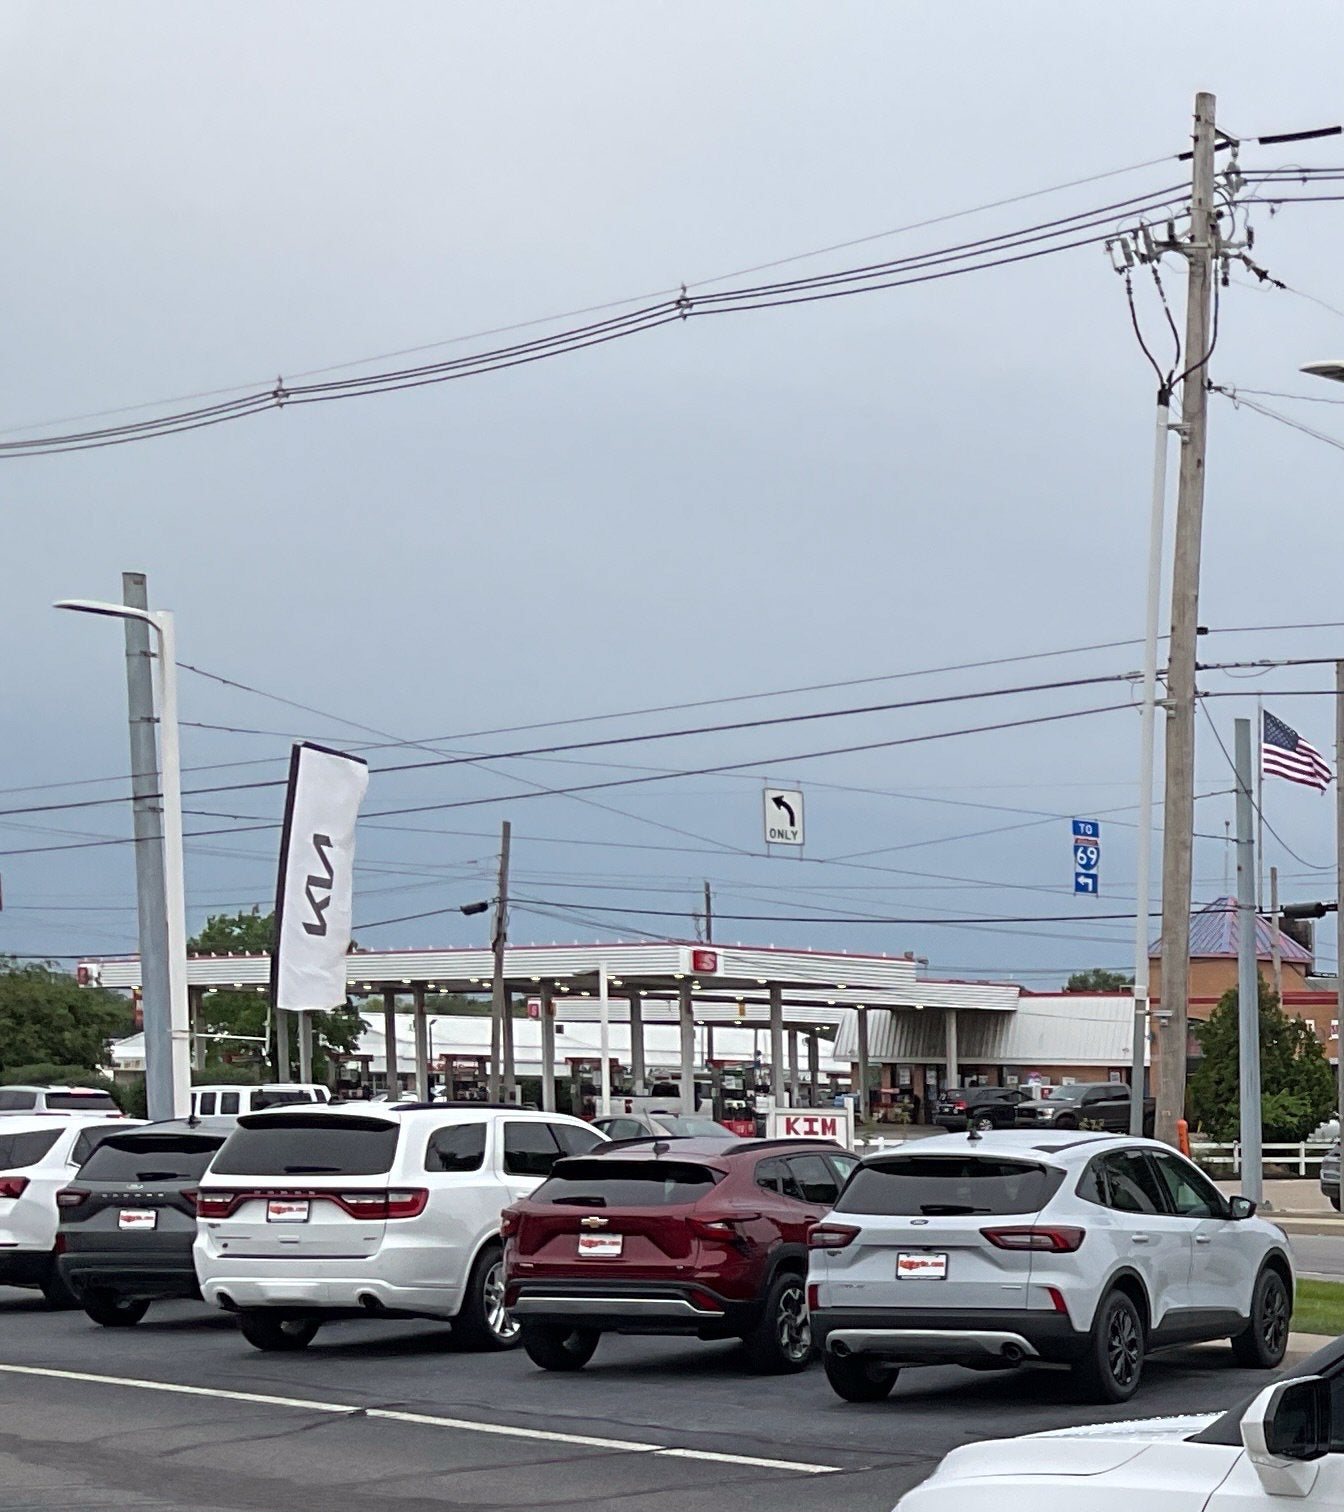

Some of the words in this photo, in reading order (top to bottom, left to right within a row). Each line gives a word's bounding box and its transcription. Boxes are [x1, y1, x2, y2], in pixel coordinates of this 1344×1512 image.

[769, 828, 799, 841] ONLY
[1078, 823, 1093, 835] TO
[1076, 846, 1098, 865] 69
[785, 1117, 837, 1136] KIM
